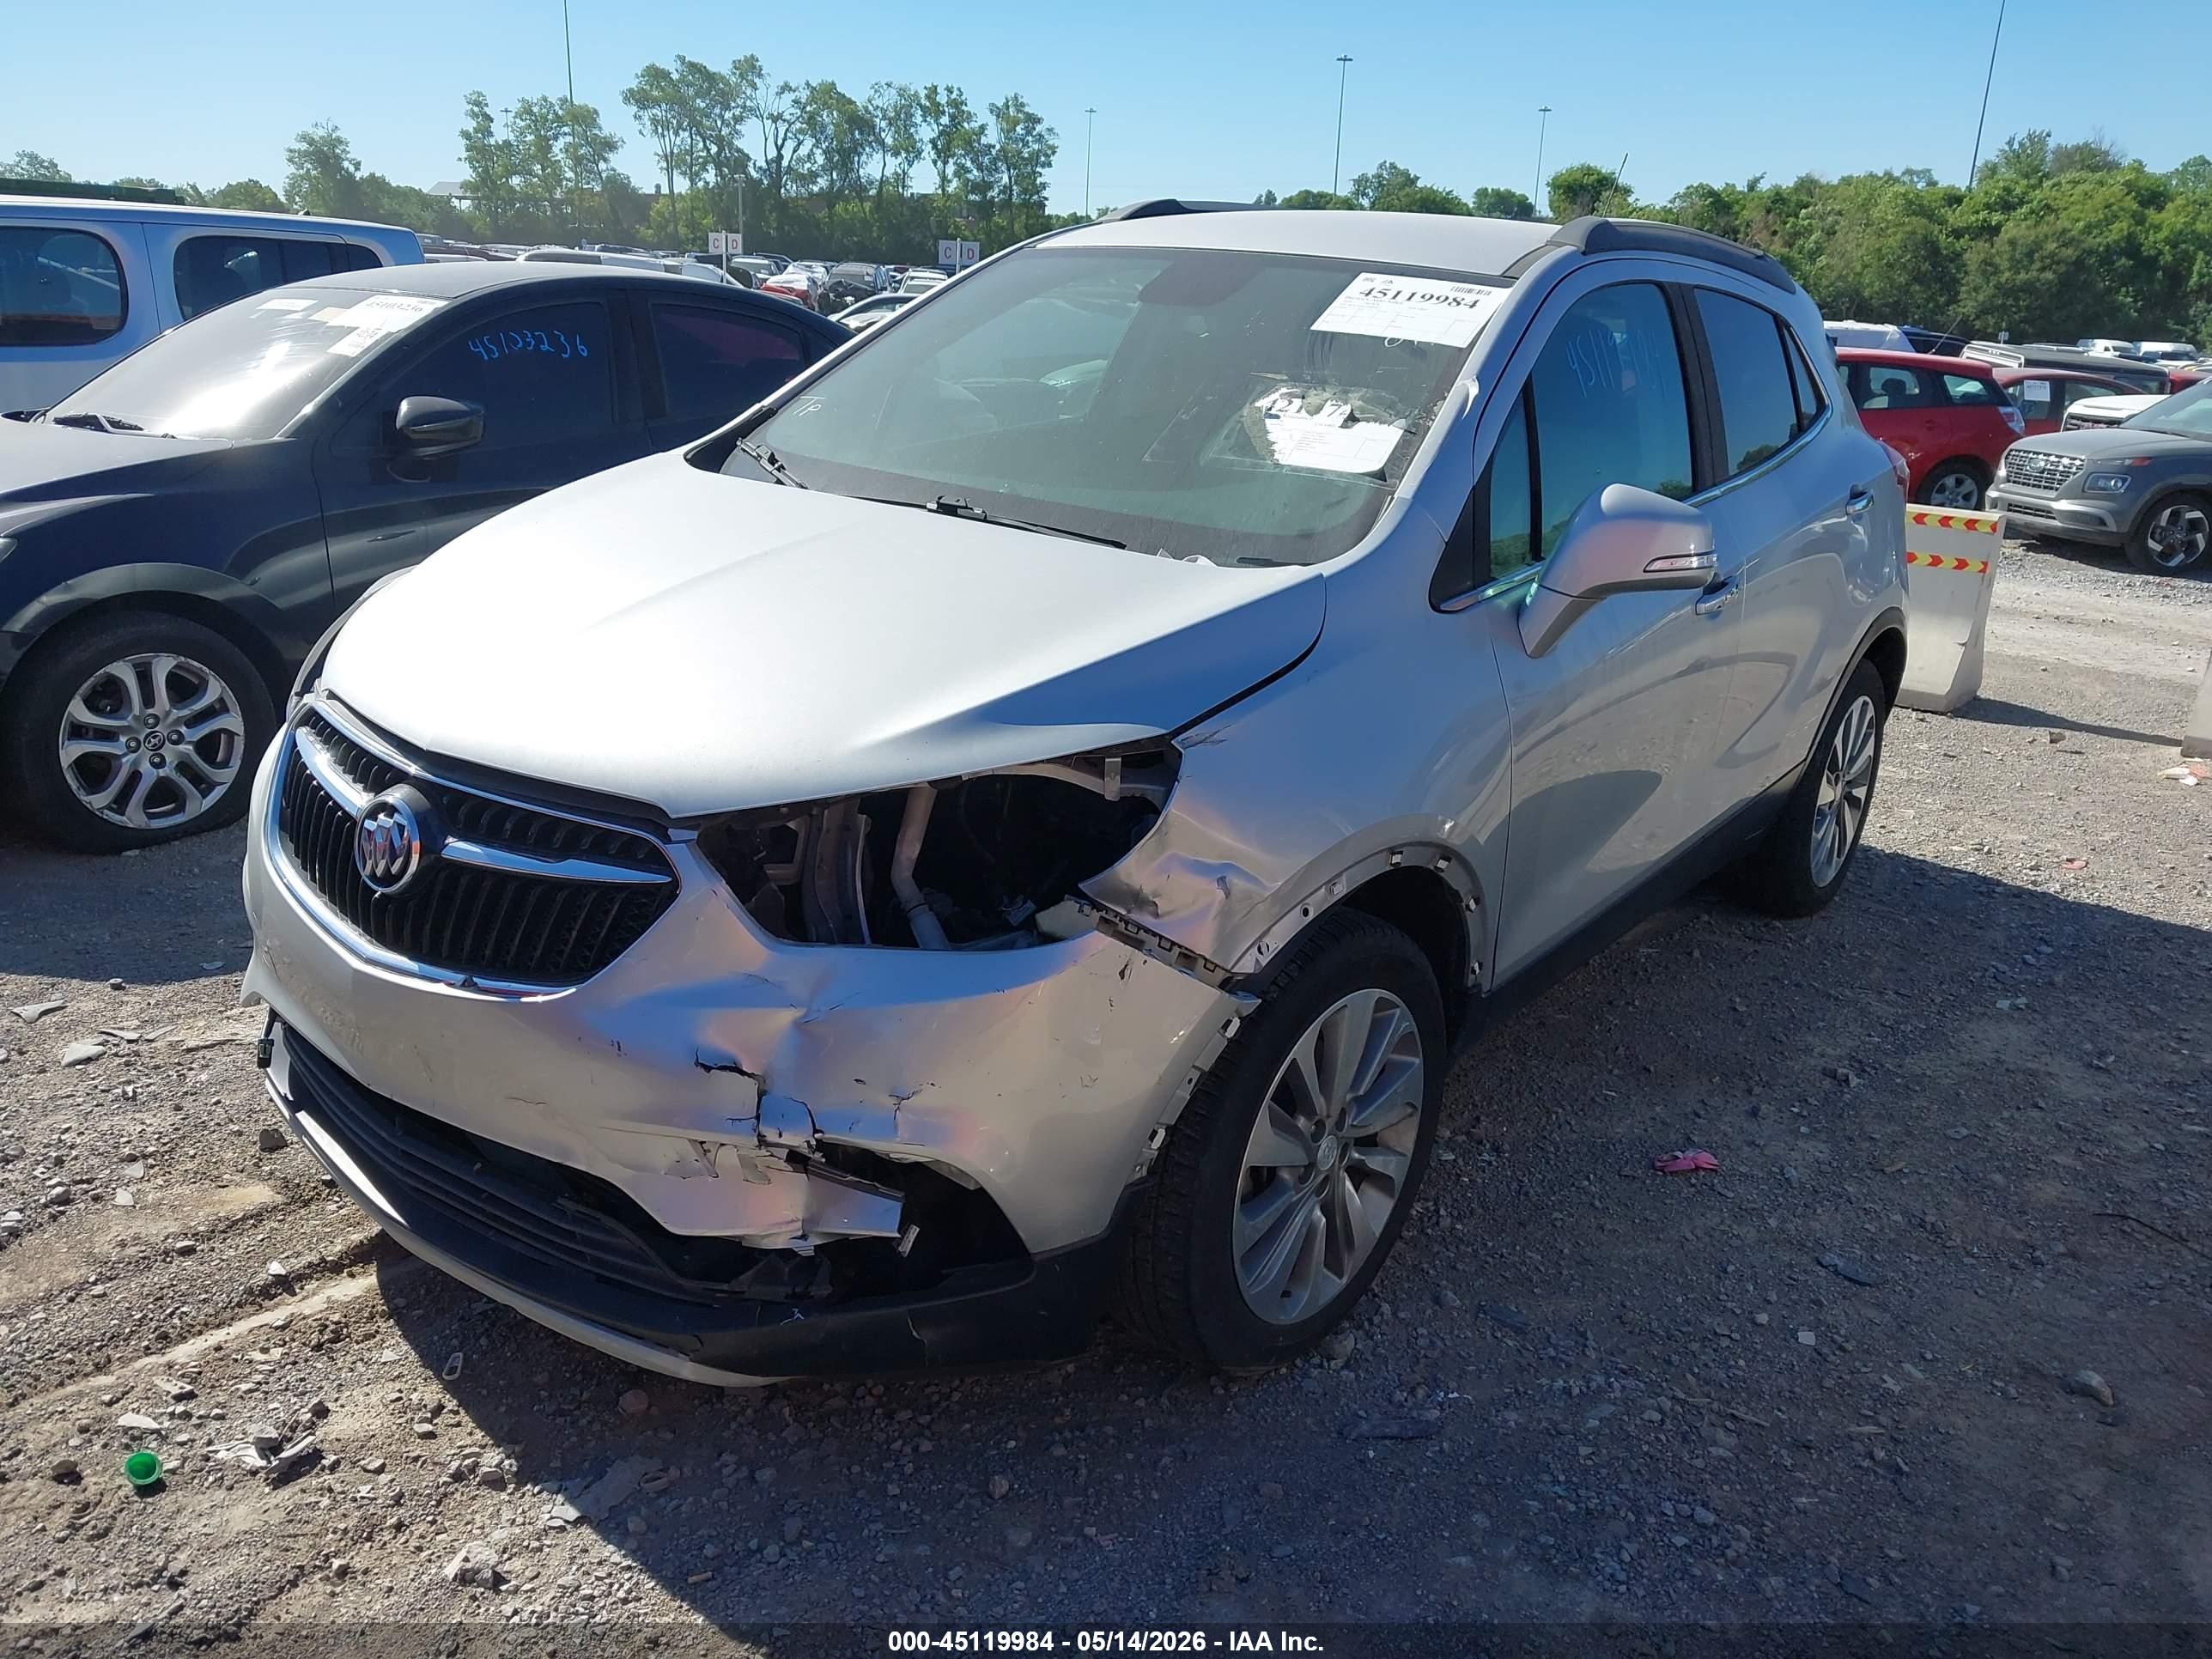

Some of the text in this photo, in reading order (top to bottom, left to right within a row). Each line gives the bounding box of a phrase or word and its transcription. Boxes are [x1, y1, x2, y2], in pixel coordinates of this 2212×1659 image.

[713, 238, 720, 249] C
[732, 239, 738, 249] D
[944, 246, 952, 259] C
[967, 248, 975, 260] D
[1359, 287, 1480, 309] 45119984
[468, 330, 588, 360] 45103236
